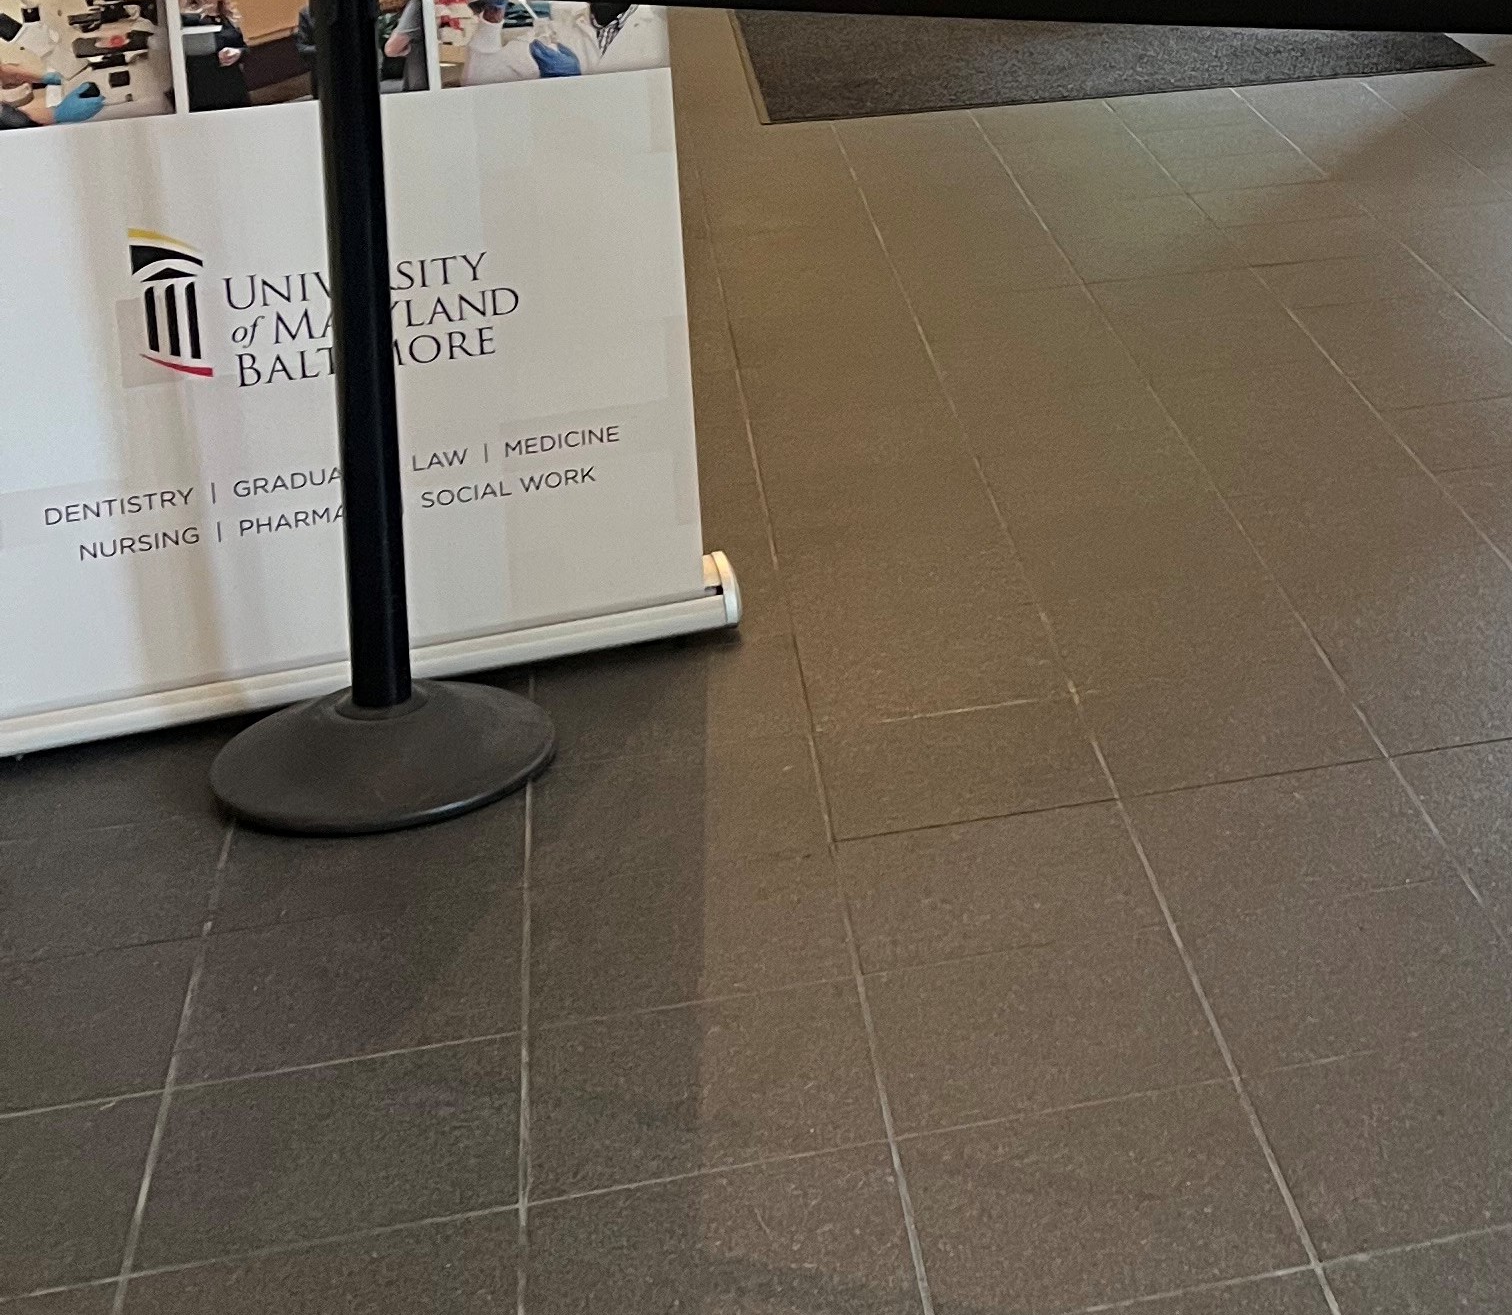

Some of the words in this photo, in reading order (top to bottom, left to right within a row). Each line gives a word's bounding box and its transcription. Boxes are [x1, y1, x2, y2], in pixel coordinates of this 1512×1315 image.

[231, 315, 266, 348] of
[44, 487, 194, 526] DENTISTRY
[412, 448, 468, 472] LAW
[504, 425, 621, 458] MEDICINE
[79, 527, 200, 562] NURSING
[421, 481, 513, 509] SOCIAL
[520, 466, 596, 493] WORK
